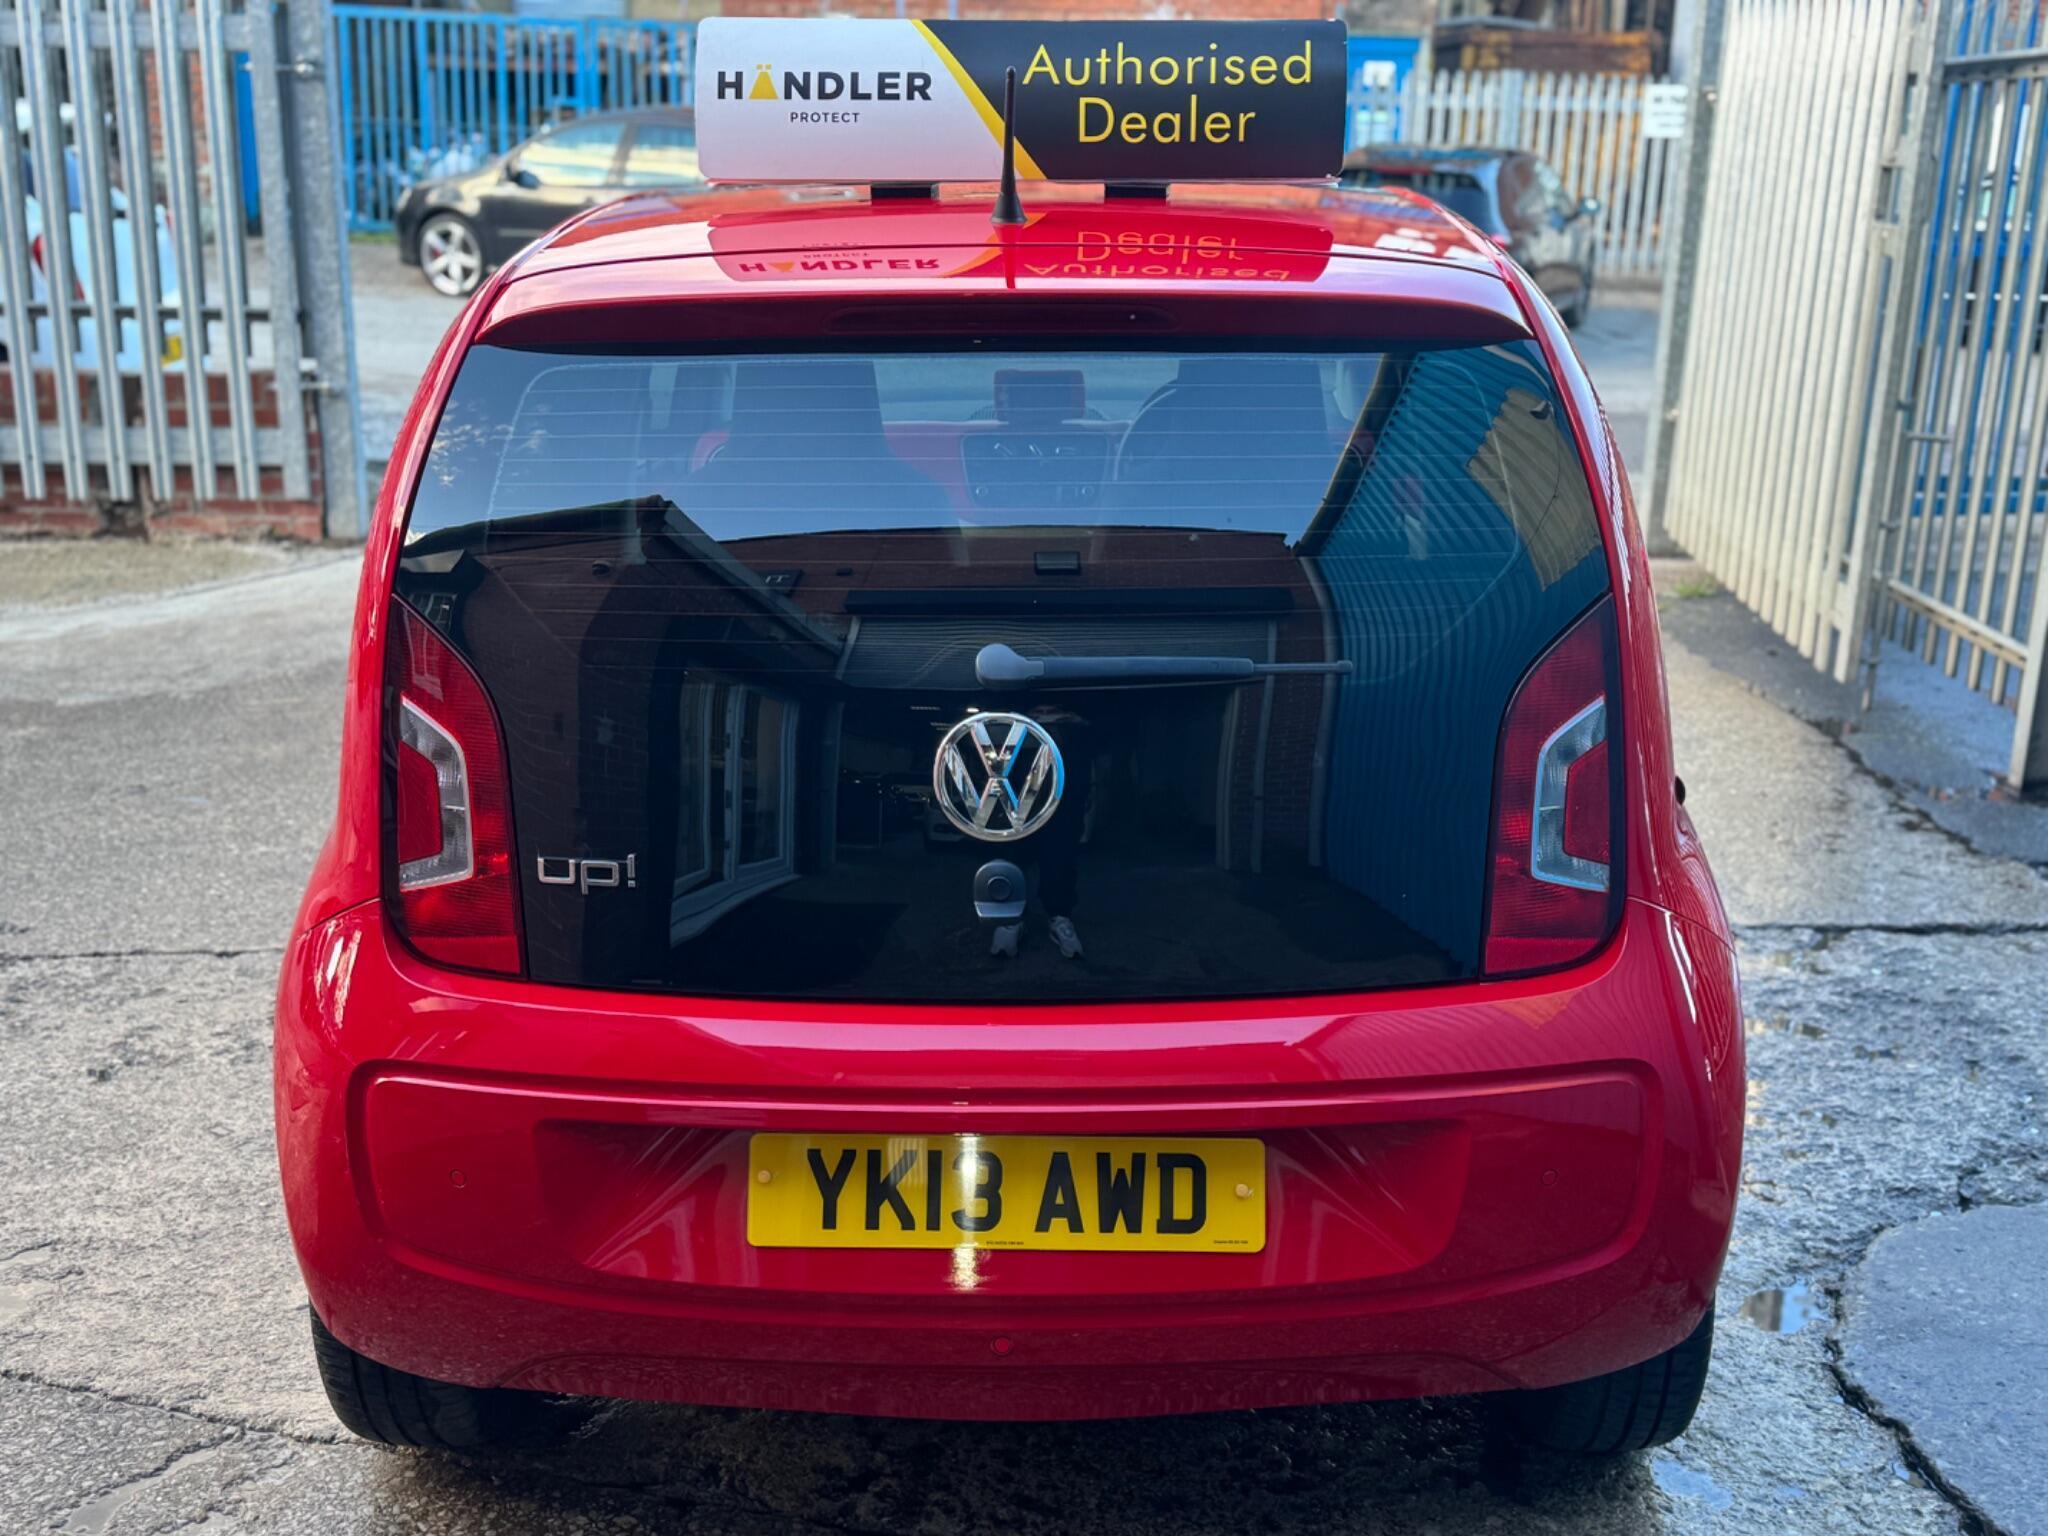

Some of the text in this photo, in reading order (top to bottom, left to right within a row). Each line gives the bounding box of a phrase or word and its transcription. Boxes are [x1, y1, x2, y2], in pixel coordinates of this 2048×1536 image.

[1022, 40, 1312, 86] Authorised
[790, 112, 860, 123] PROTECT
[1078, 94, 1256, 143] Dealer
[537, 853, 636, 895] up!
[807, 1148, 1207, 1234] YK13 AWD
